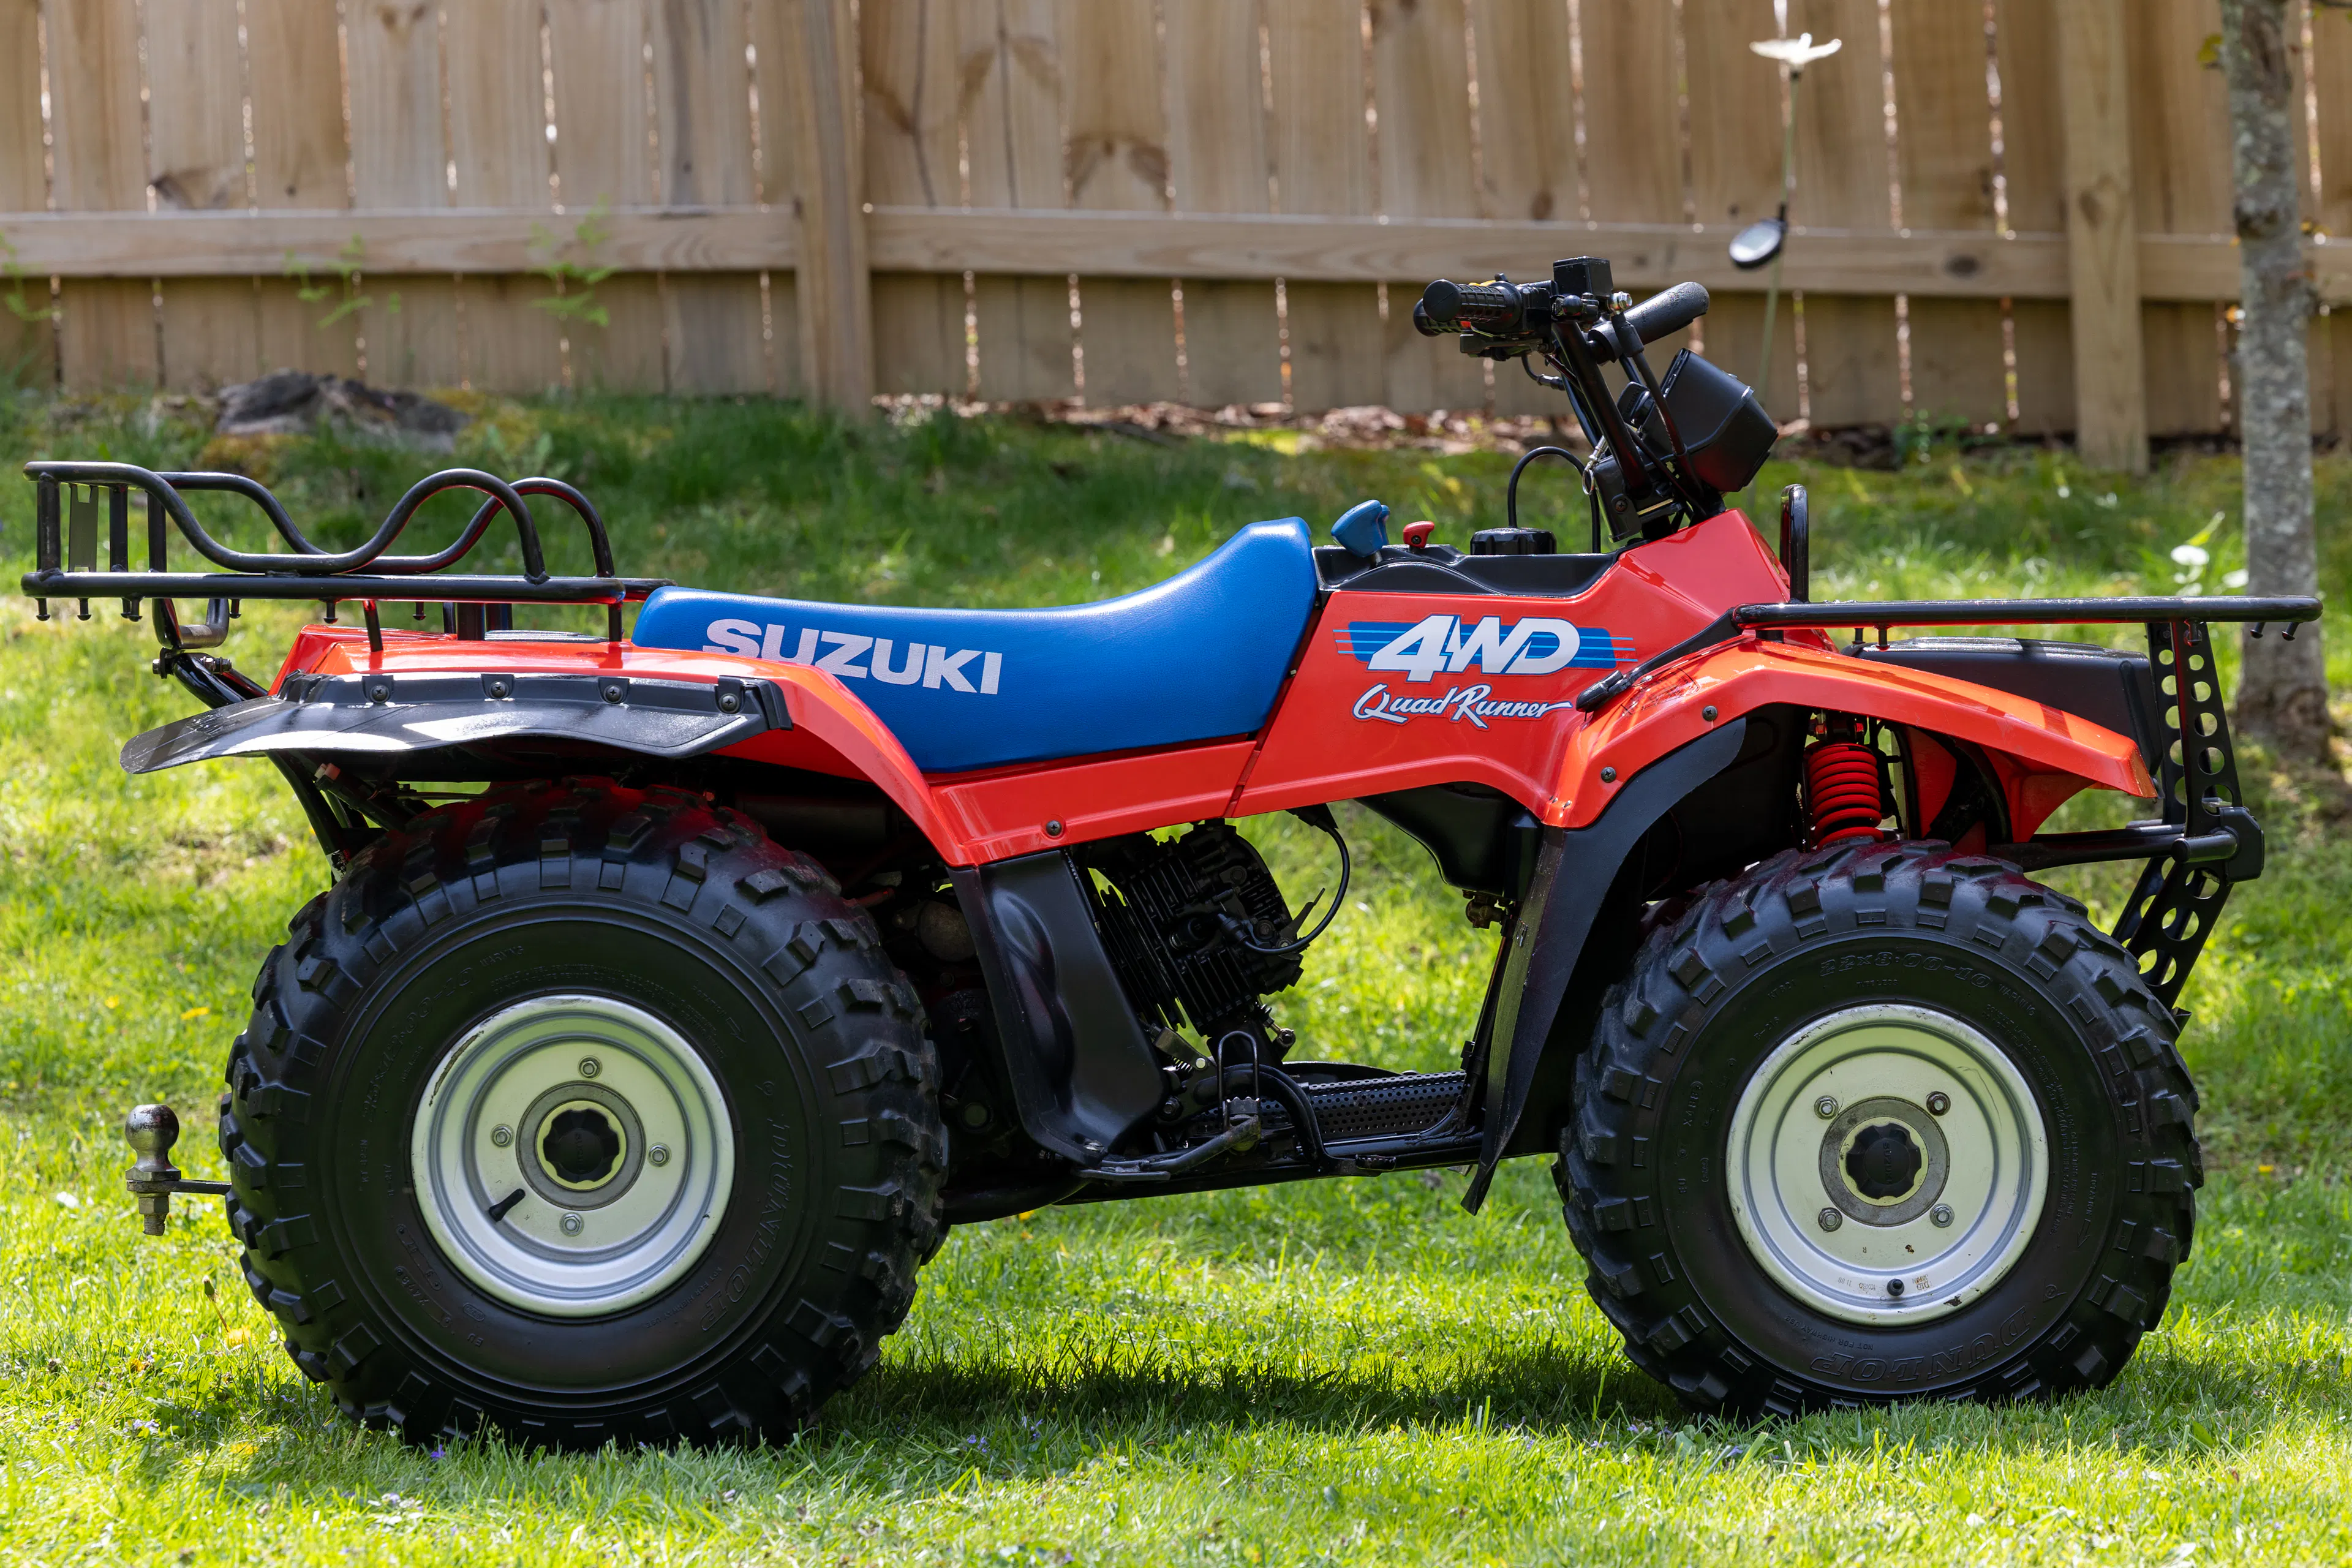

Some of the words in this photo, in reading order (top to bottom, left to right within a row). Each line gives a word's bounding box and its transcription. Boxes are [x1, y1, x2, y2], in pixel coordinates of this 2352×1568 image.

[703, 619, 1003, 695] SUZUKI
[1368, 614, 1581, 682] 4WD
[2084, 1172, 2098, 1216] ROTATION
[699, 1118, 794, 1333] DUNLOP
[707, 1265, 724, 1283] NOT
[693, 1280, 710, 1297] FOR
[644, 1315, 663, 1329] USE
[1783, 1313, 1800, 1328] USE
[465, 1332, 484, 1348] EU
[1800, 1324, 1836, 1344] HIGHWAY
[1837, 1338, 1855, 1348] FOR
[1810, 1304, 2032, 1383] DUNLOP
[1856, 1341, 1873, 1351] NOT
